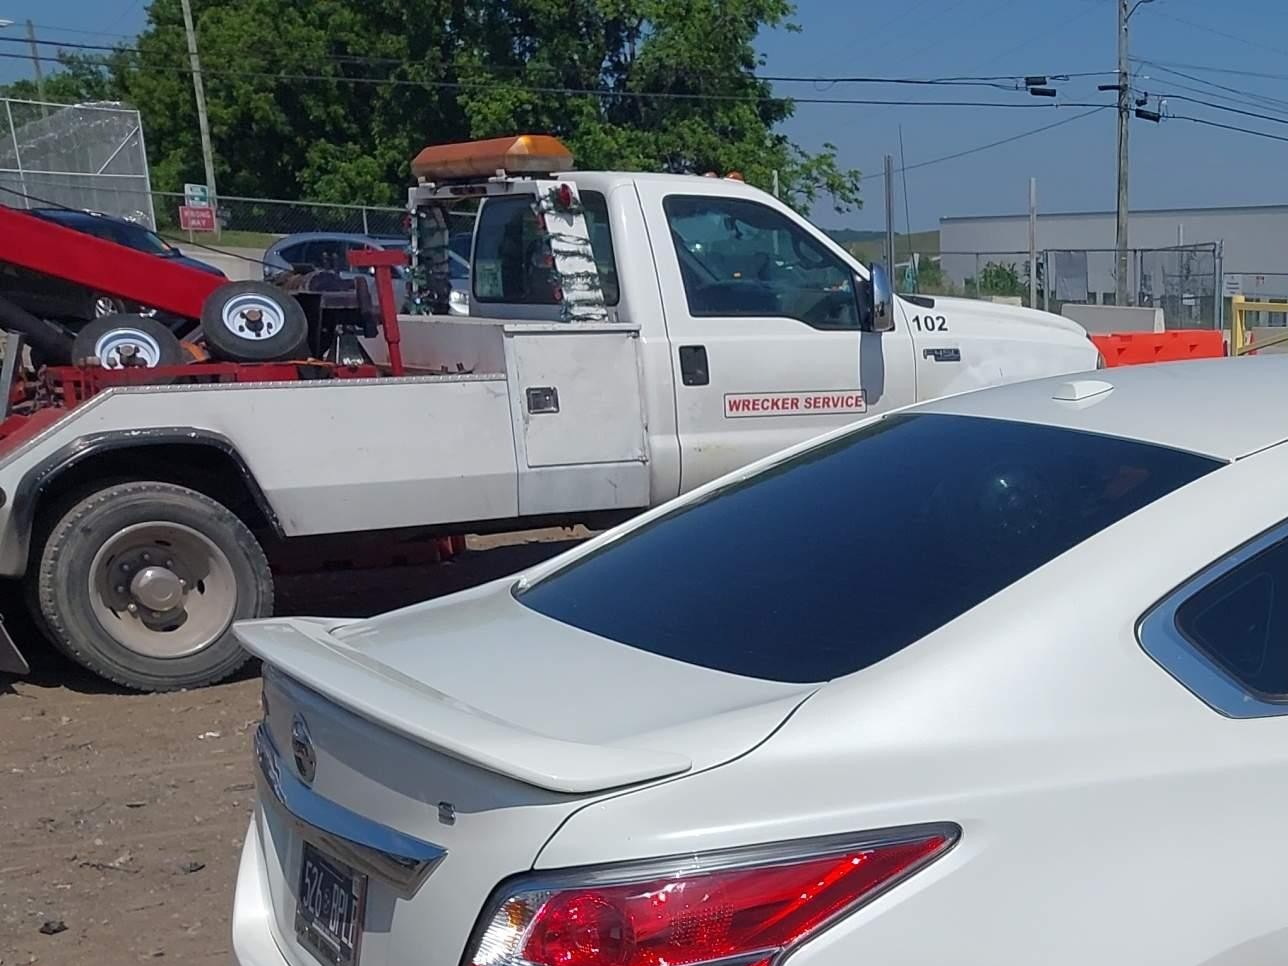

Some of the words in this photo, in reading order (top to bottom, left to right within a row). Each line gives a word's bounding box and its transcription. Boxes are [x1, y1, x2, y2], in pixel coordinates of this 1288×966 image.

[912, 315, 948, 332] 102
[728, 398, 799, 412] WRECKER
[804, 395, 863, 409] SERVICE
[303, 860, 324, 918] 526
